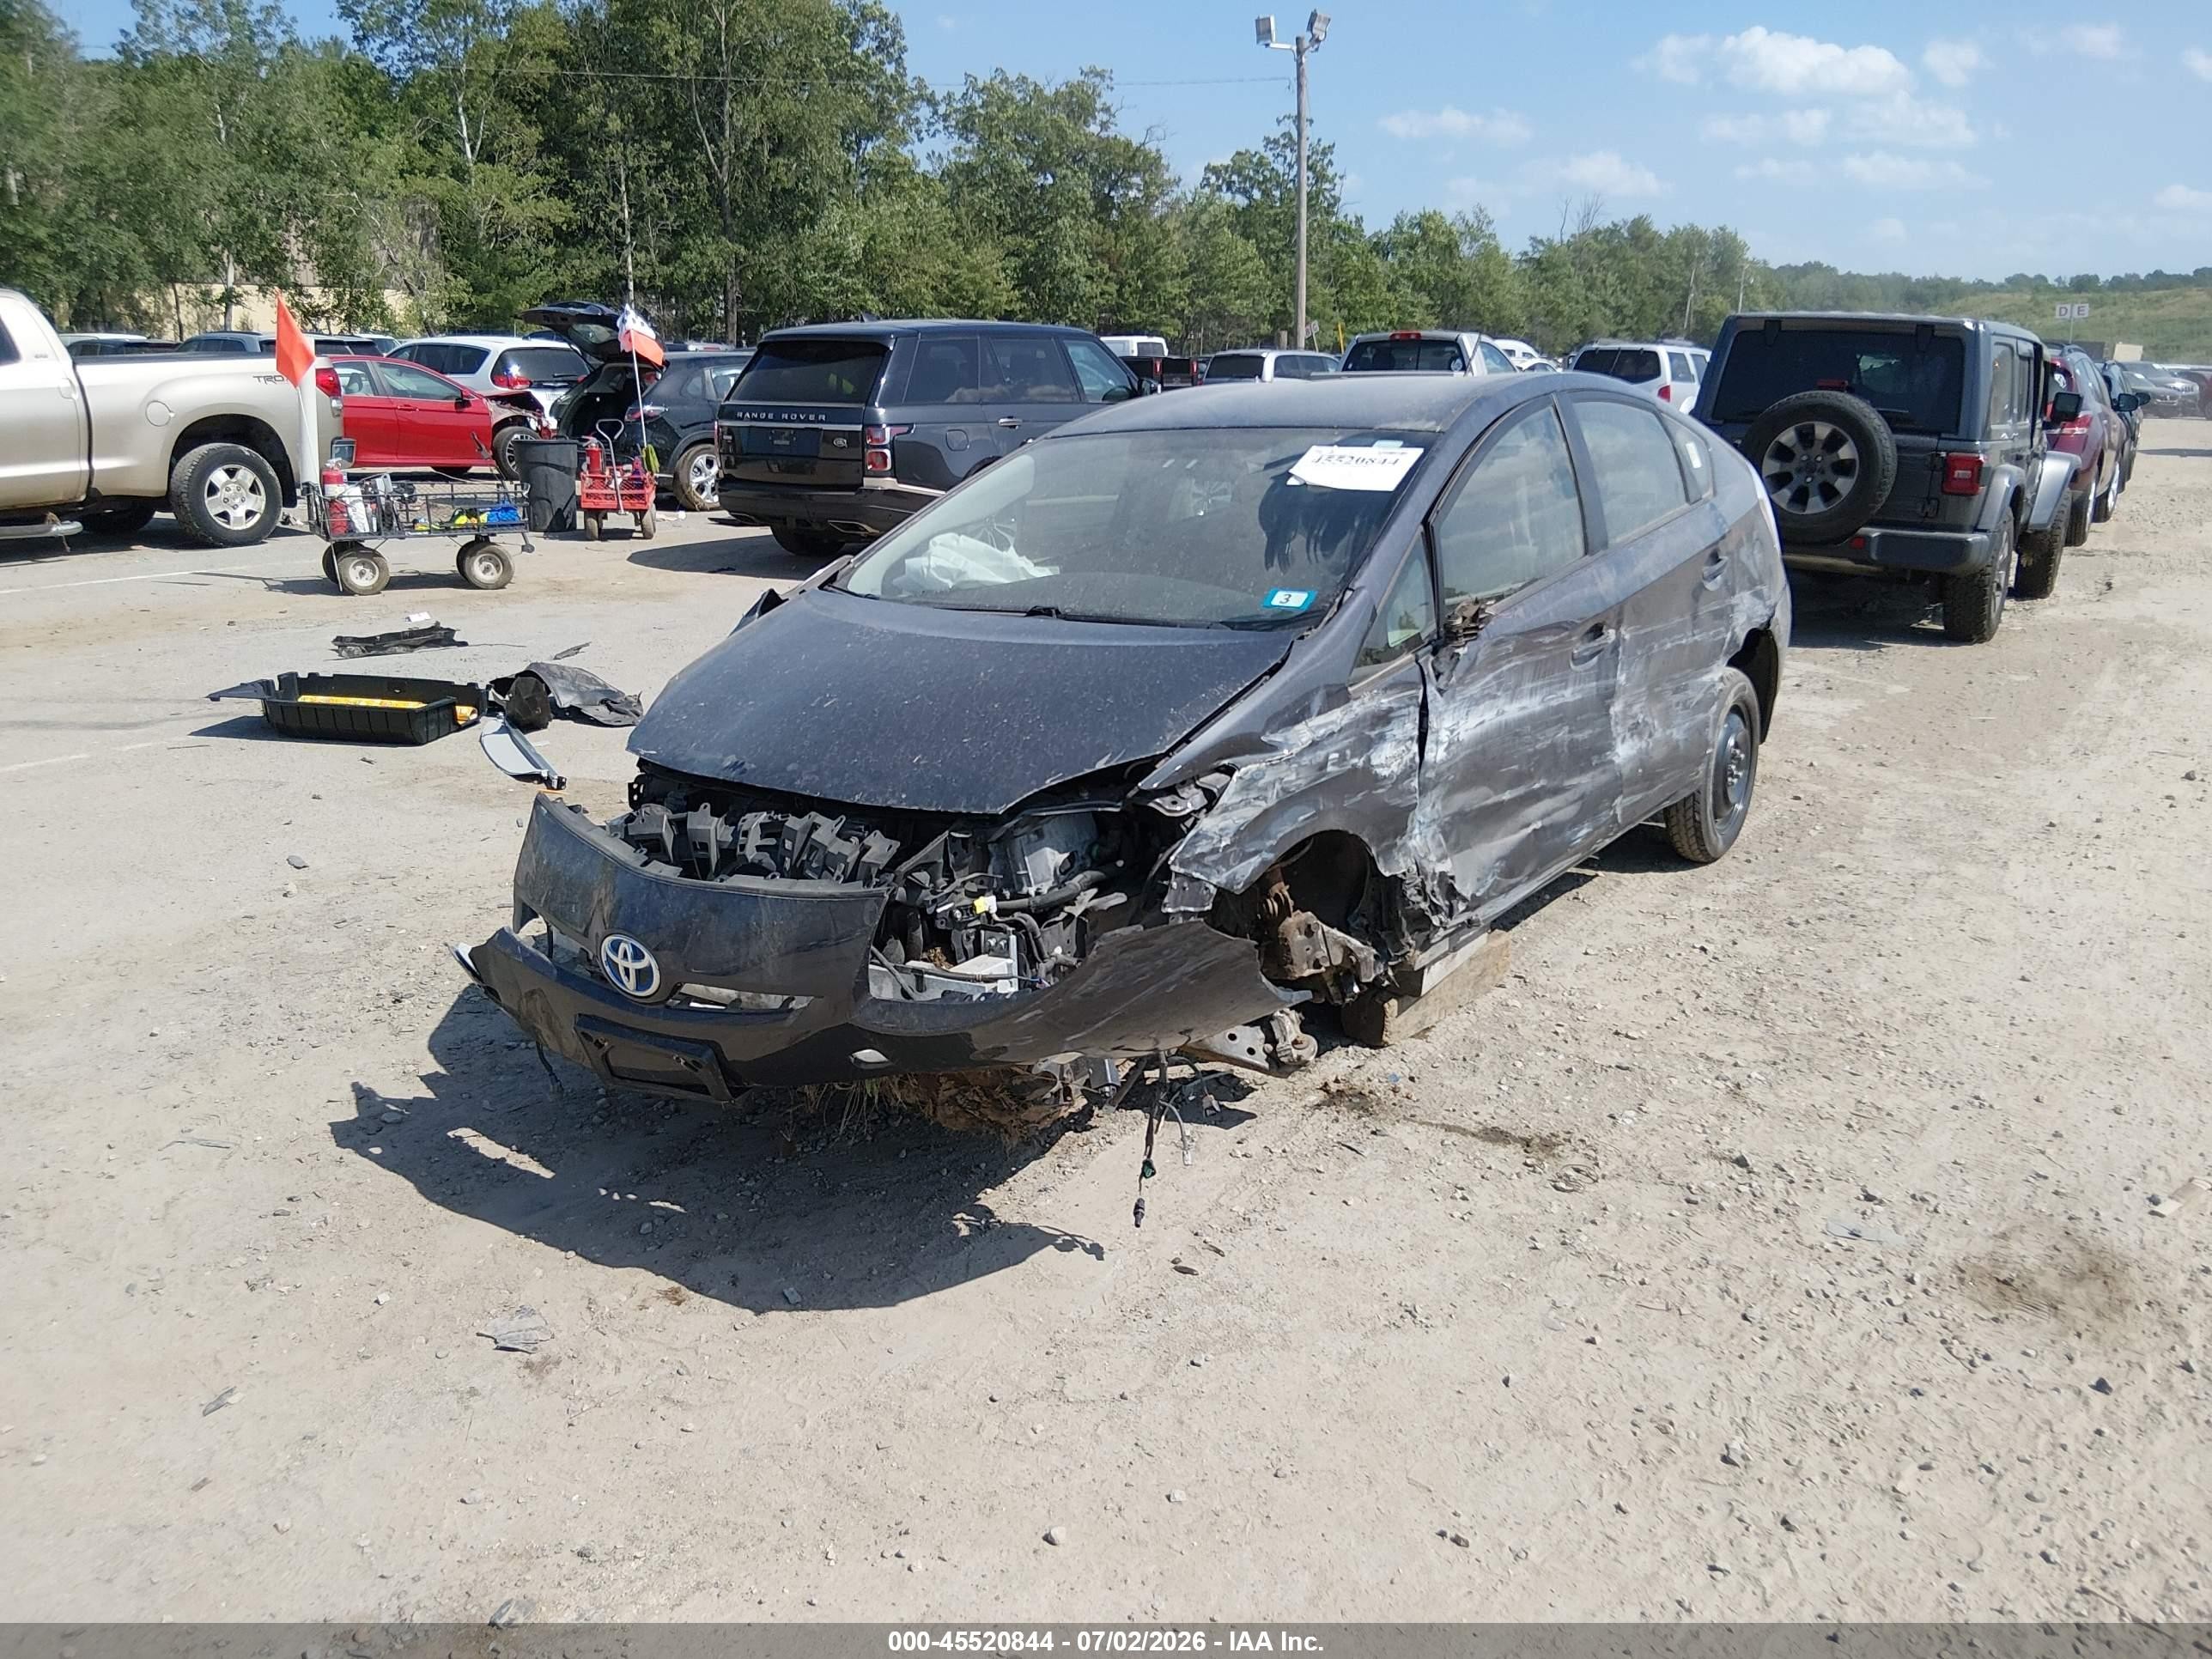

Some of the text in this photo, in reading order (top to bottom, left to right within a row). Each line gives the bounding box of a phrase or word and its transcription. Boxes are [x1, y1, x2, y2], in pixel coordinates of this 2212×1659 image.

[2058, 305, 2087, 317] D E
[252, 374, 285, 385] TRD
[736, 410, 826, 422] RANGE ROVER
[1279, 593, 1292, 605] 3
